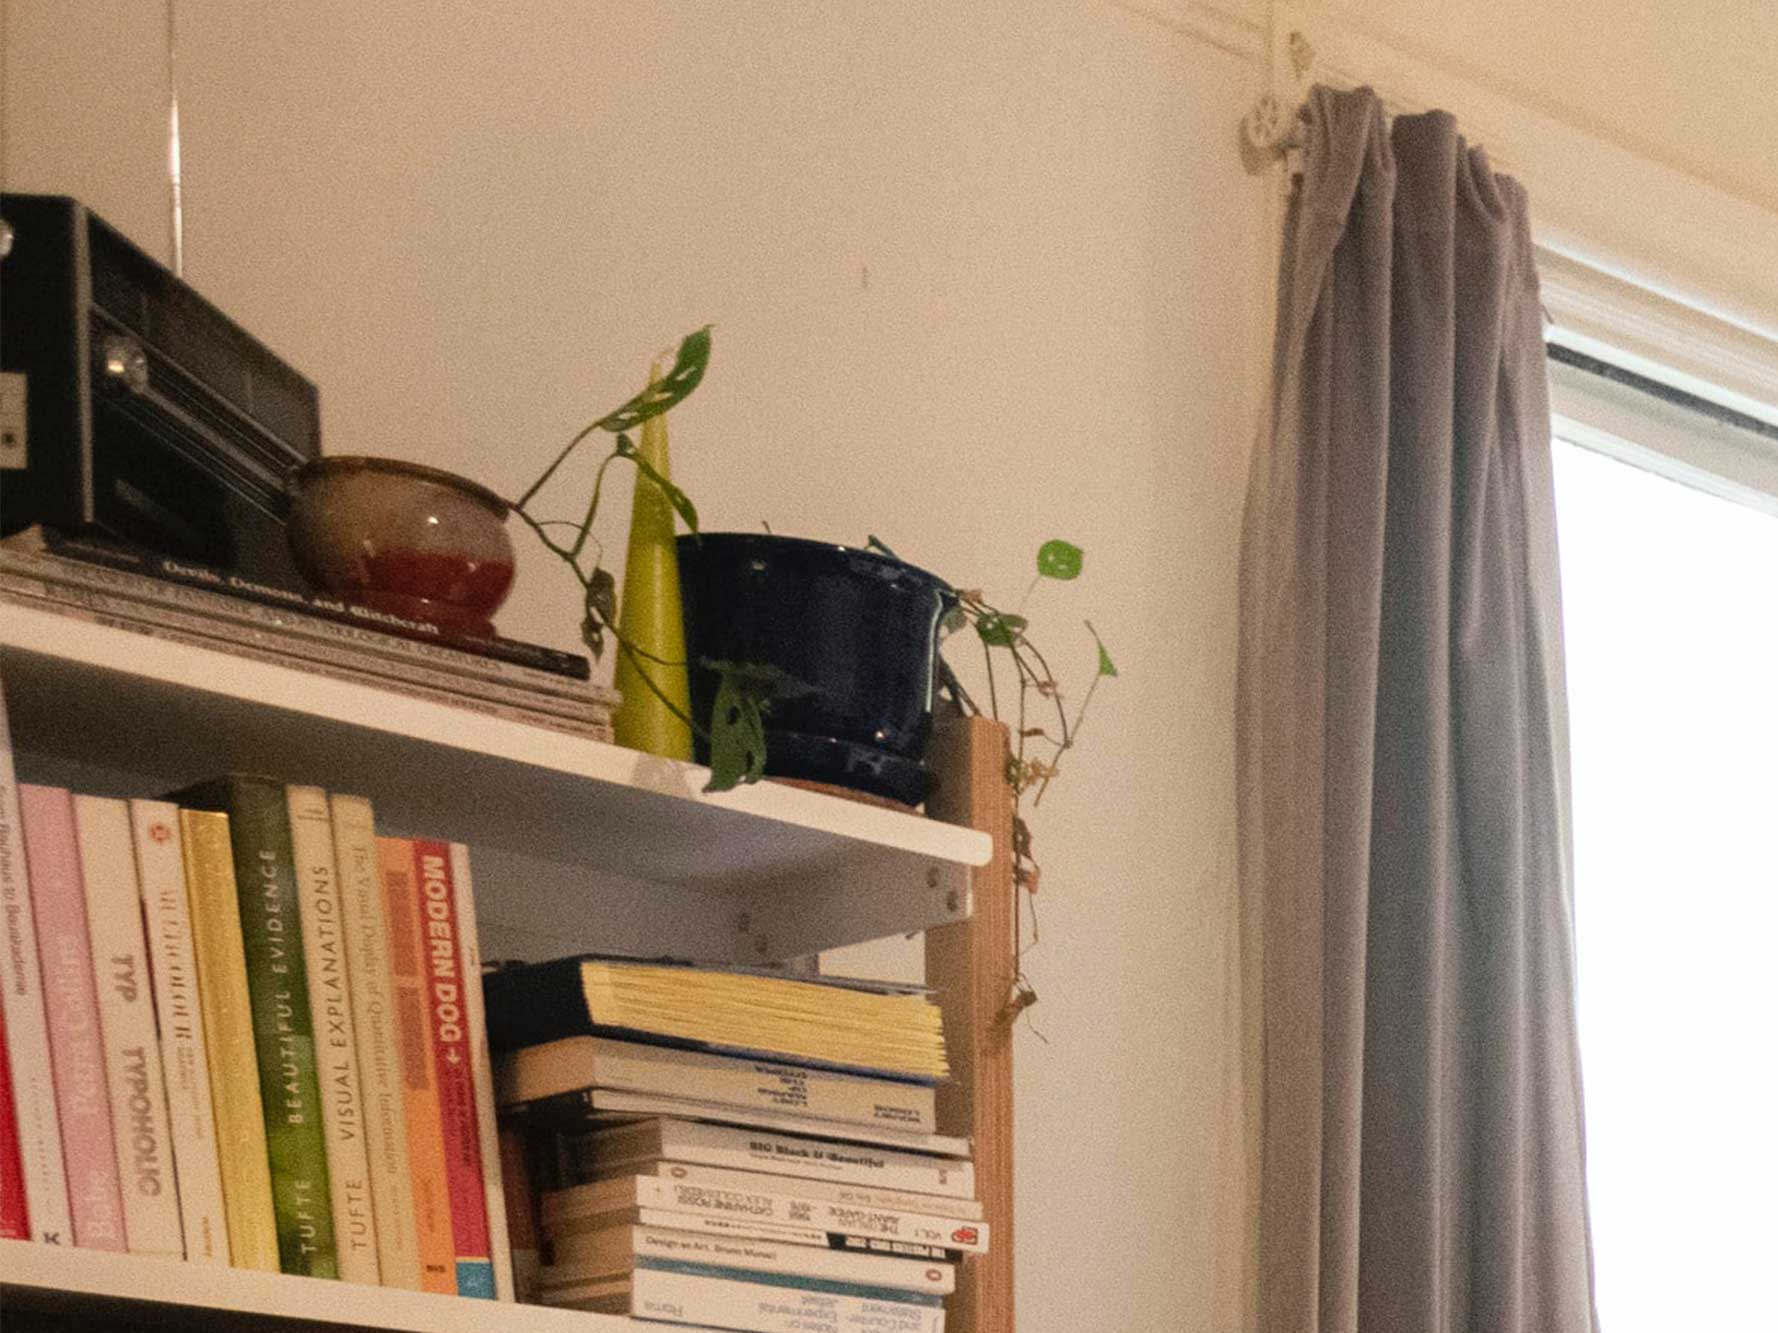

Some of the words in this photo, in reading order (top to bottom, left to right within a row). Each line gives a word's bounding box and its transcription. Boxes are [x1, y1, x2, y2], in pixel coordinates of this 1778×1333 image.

[259, 849, 287, 974] EVIDENCE
[317, 866, 346, 1047] EXPLANATIONS
[423, 856, 454, 977] MODERN
[112, 954, 136, 1003] TYP
[435, 983, 462, 1042] DOG
[276, 991, 304, 1125] BEAUTIFUL
[337, 1060, 356, 1142] VISUAL
[122, 1046, 161, 1197] TYPOHOLIC
[294, 1178, 316, 1254] TUFTE
[350, 1177, 368, 1252] TUFTE
